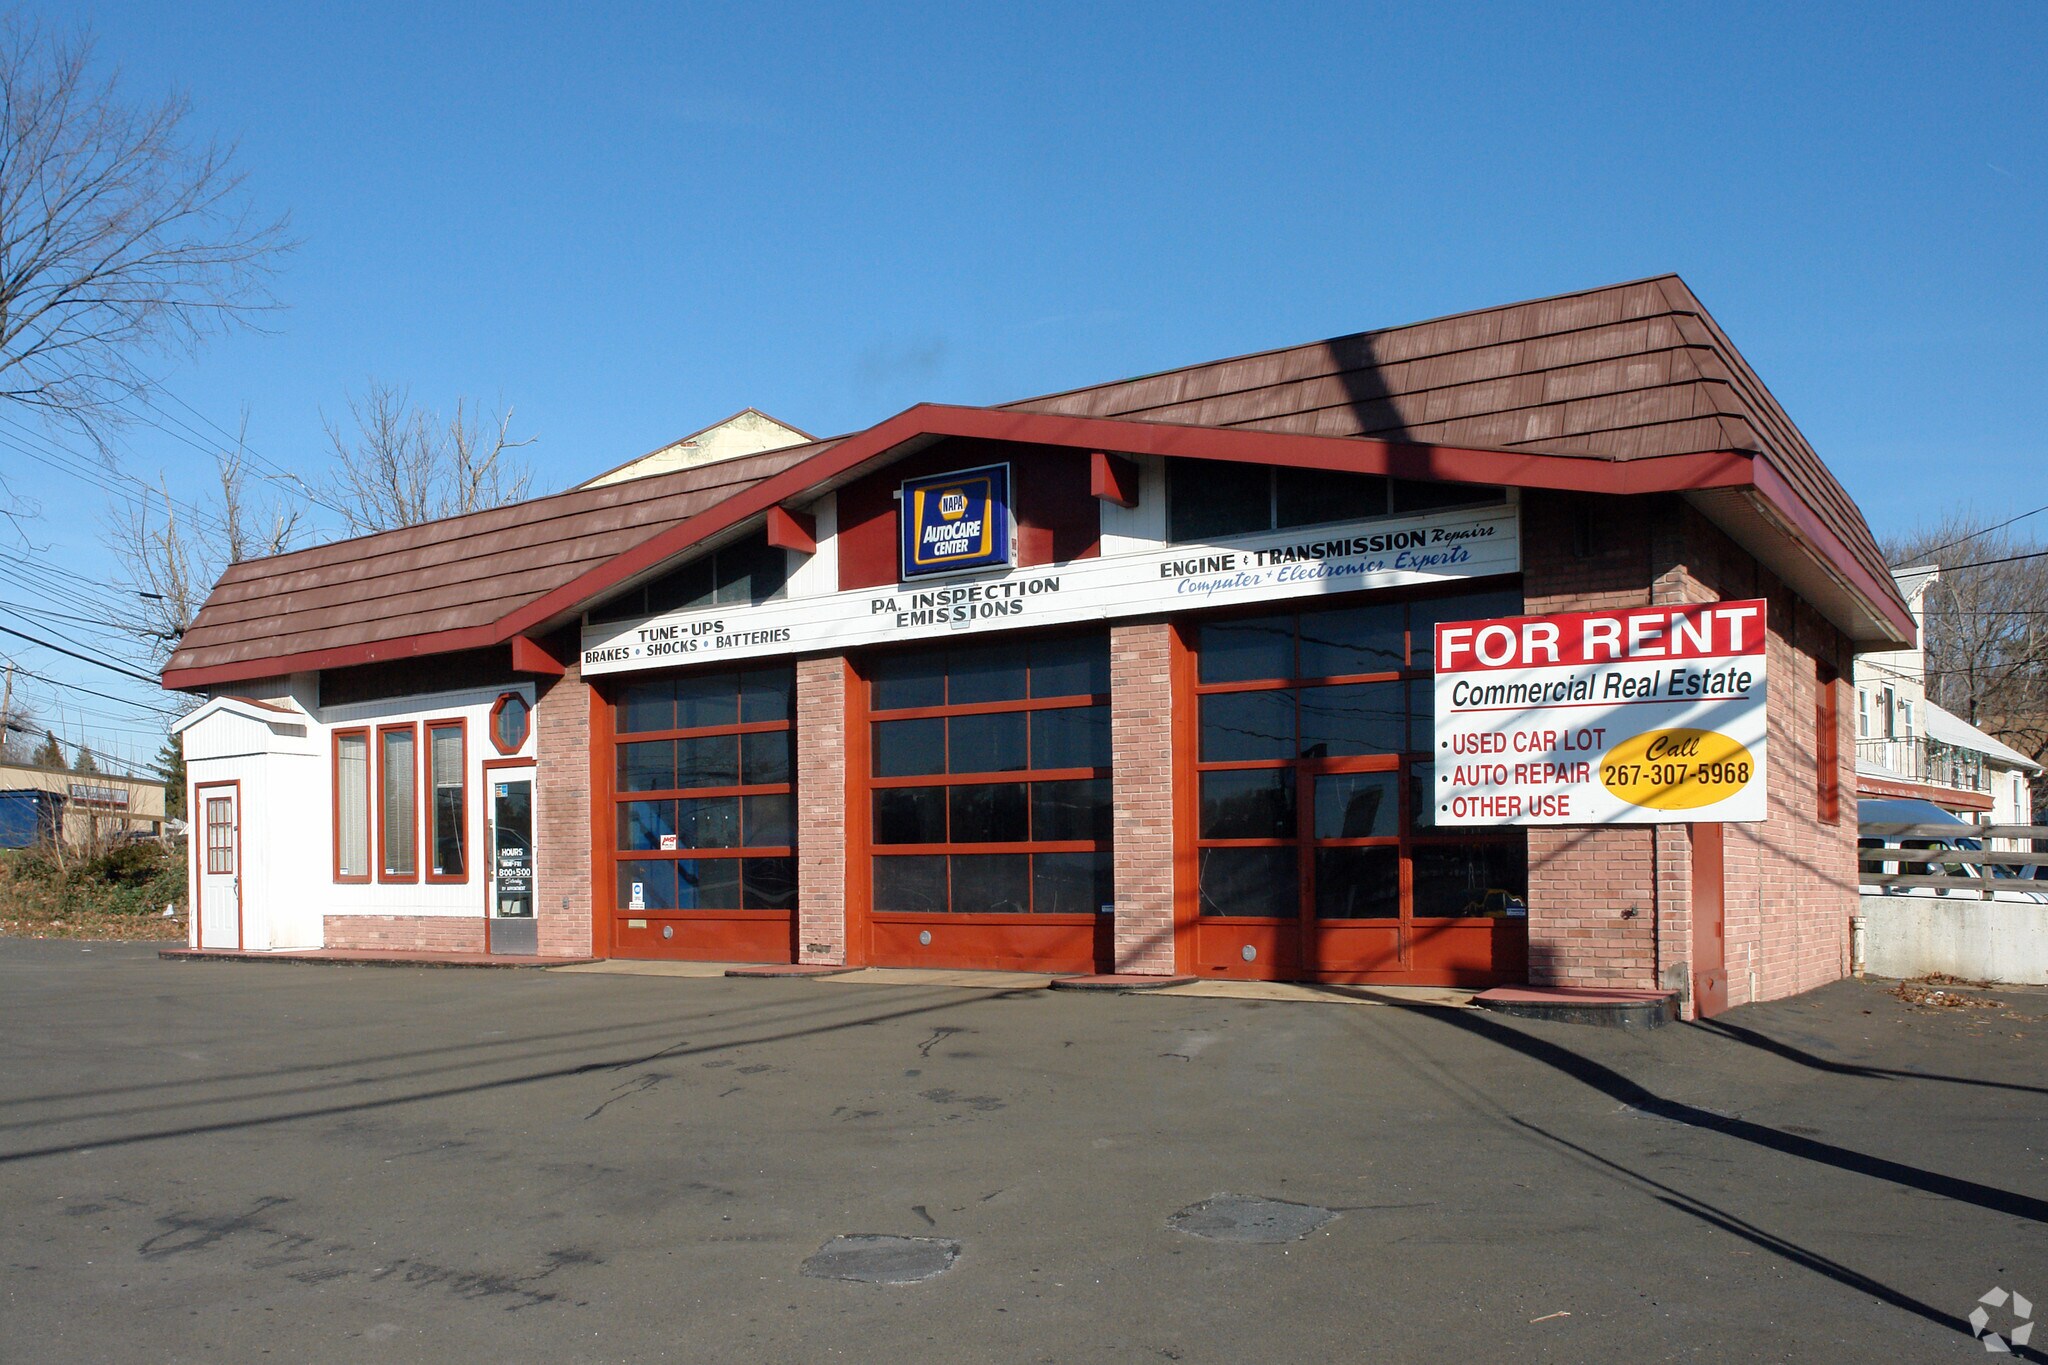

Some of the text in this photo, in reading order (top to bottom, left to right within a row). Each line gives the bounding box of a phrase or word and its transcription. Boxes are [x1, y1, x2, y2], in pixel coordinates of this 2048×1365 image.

[943, 495, 963, 512] NAPA
[934, 539, 969, 556] CENTER
[1160, 554, 1235, 579] ENGINE
[1252, 529, 1427, 567] TRANSMISSION
[1431, 523, 1497, 548] Repairs
[1177, 571, 1262, 599] Computer
[1277, 556, 1386, 584] Electronics
[1393, 544, 1473, 573] Experts
[870, 576, 1061, 616] PA. INSPECTION
[895, 598, 1025, 629] EMISSIONS
[584, 627, 791, 665] BRAKES SHOCKS BATTERIES
[1441, 607, 1758, 669] FOR RENT
[1452, 666, 1753, 707] Commercial Real Estate
[1453, 727, 1606, 756] USED CAR LOT
[1645, 735, 1700, 762] Call
[1452, 761, 1591, 787] AUTO REPAIR
[1604, 762, 1750, 787] 267-307-5968
[1452, 794, 1570, 818] OTHER USE
[501, 848, 523, 857] HOURS
